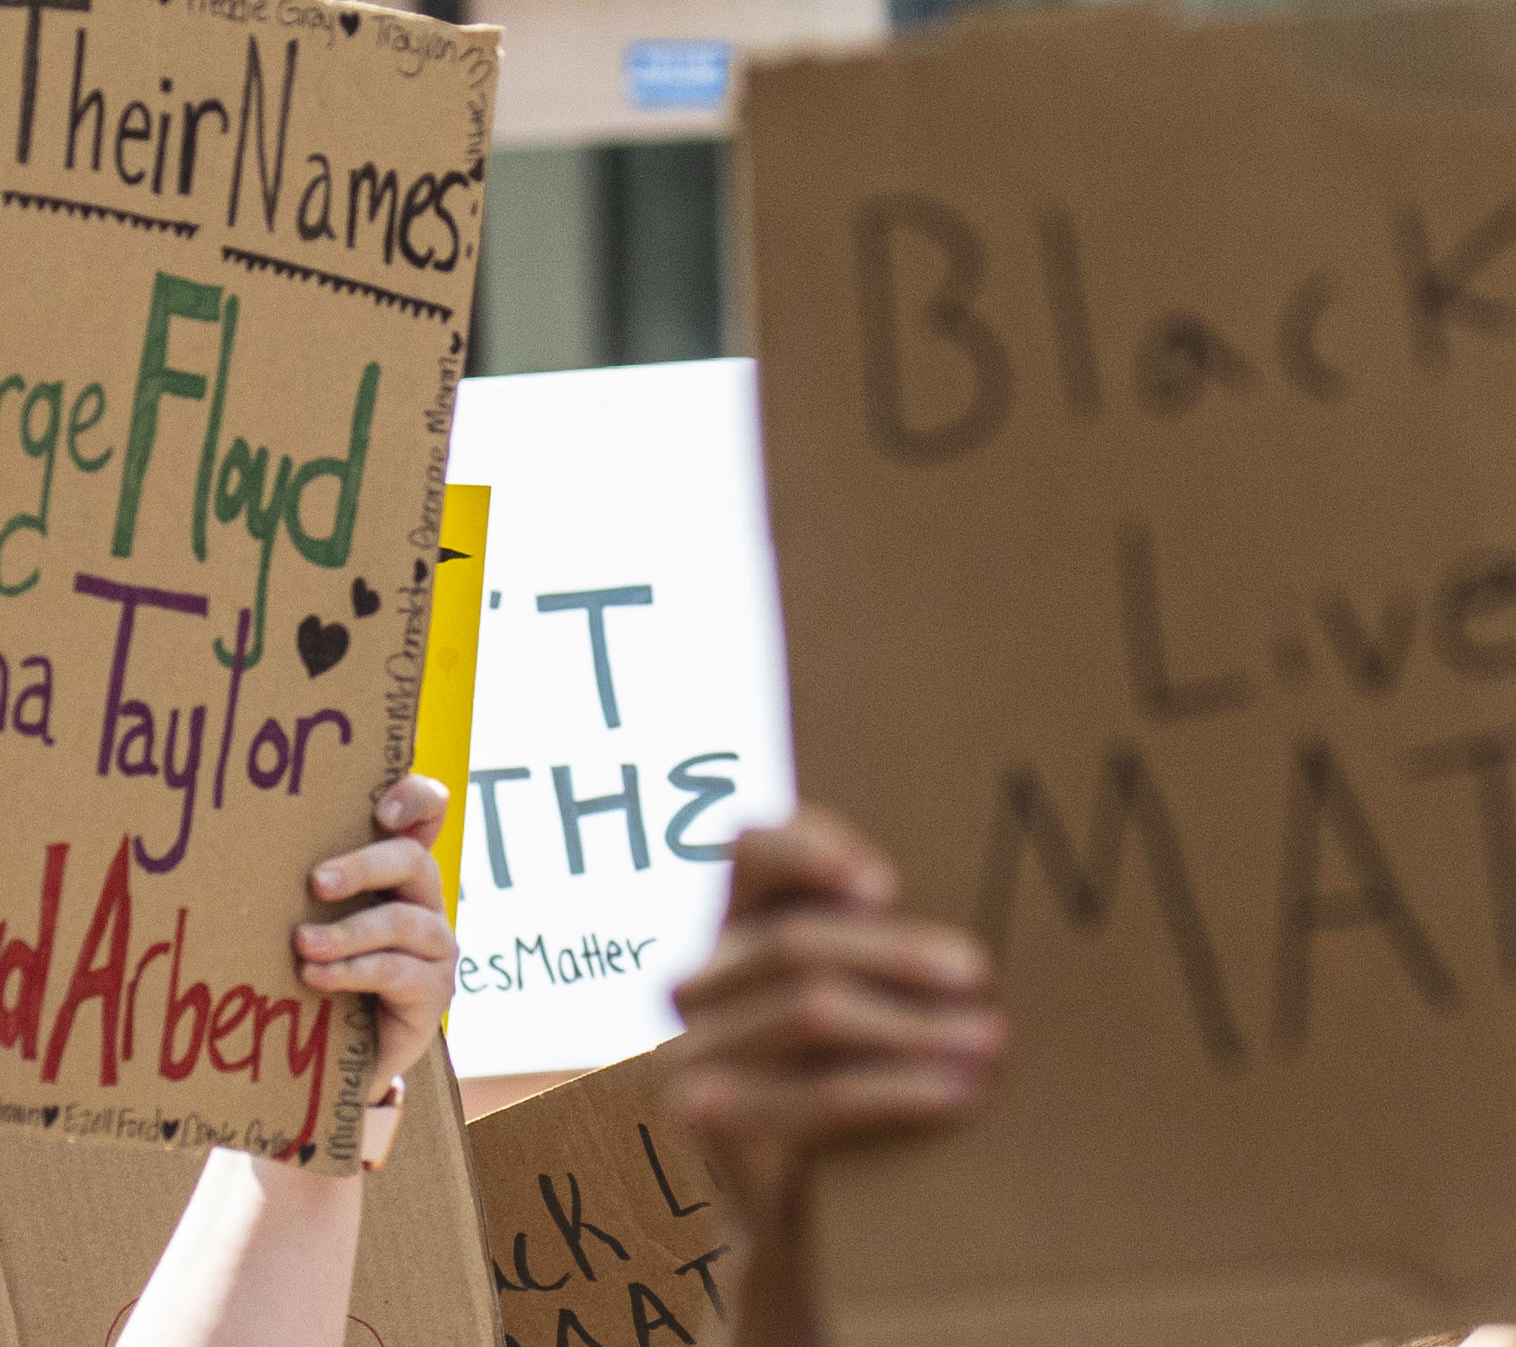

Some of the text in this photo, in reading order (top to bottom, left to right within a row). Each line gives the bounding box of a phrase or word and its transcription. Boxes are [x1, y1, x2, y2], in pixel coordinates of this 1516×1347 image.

[110, 270, 382, 672] Floyd
[72, 571, 353, 875] Taylor
[462, 751, 740, 900] THE
[38, 832, 336, 1163] Arbery
